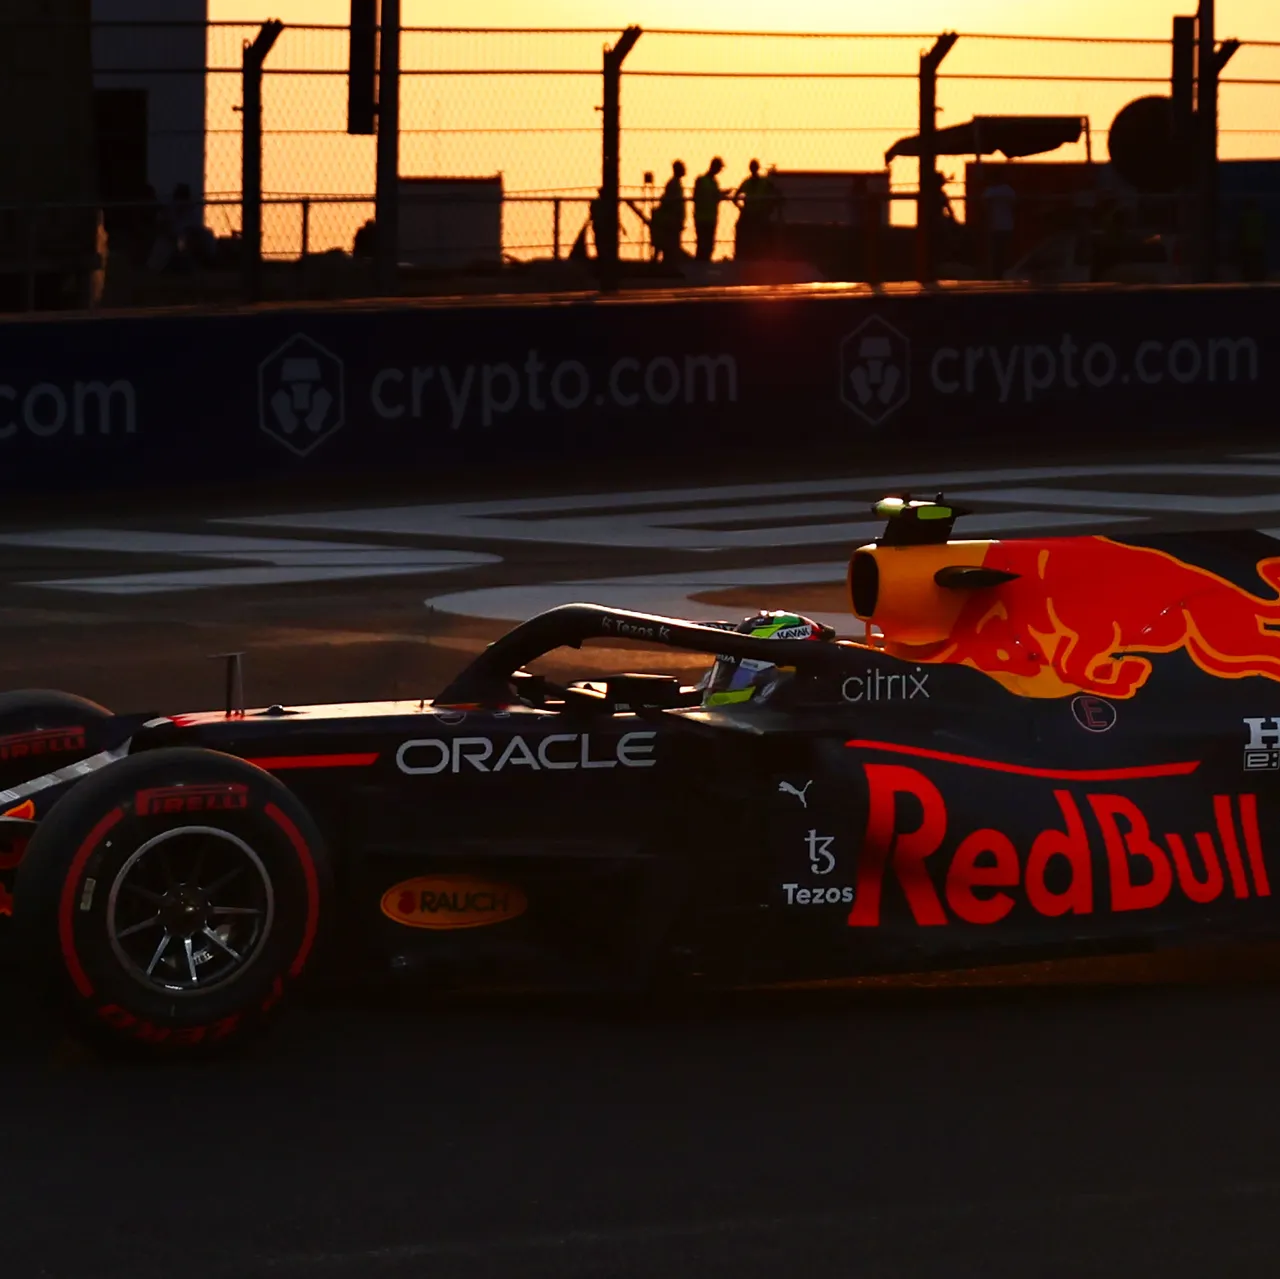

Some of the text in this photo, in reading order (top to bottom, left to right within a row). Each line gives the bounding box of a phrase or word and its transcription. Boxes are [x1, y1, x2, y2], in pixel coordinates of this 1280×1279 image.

[931, 332, 1258, 403] crypto.com
[371, 348, 738, 430] crypto.com
[841, 666, 930, 702] citrix
[395, 731, 657, 775] ORACLE
[135, 783, 249, 817] PIRELLI
[420, 890, 510, 915] RAUCH
[782, 883, 855, 905] Tezos
